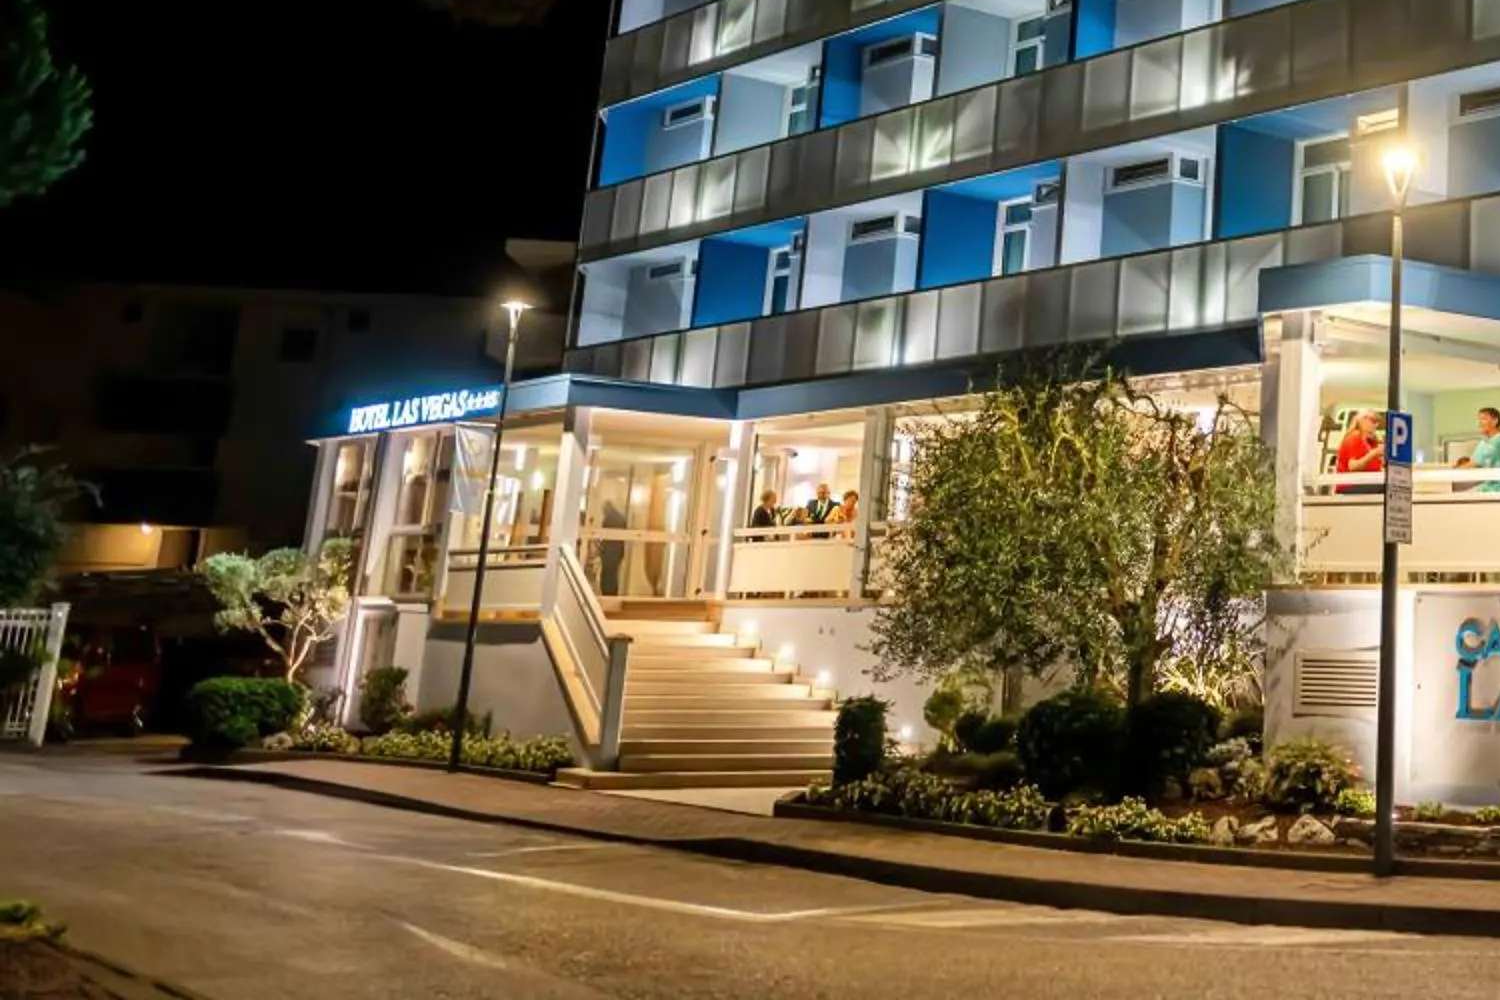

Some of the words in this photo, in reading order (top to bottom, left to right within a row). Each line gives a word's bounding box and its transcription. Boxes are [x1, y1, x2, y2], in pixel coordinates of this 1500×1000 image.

[349, 403, 392, 432] HOTEL
[392, 398, 420, 426] LAS
[421, 389, 469, 421] VEGAS
[1391, 417, 1409, 457] P
